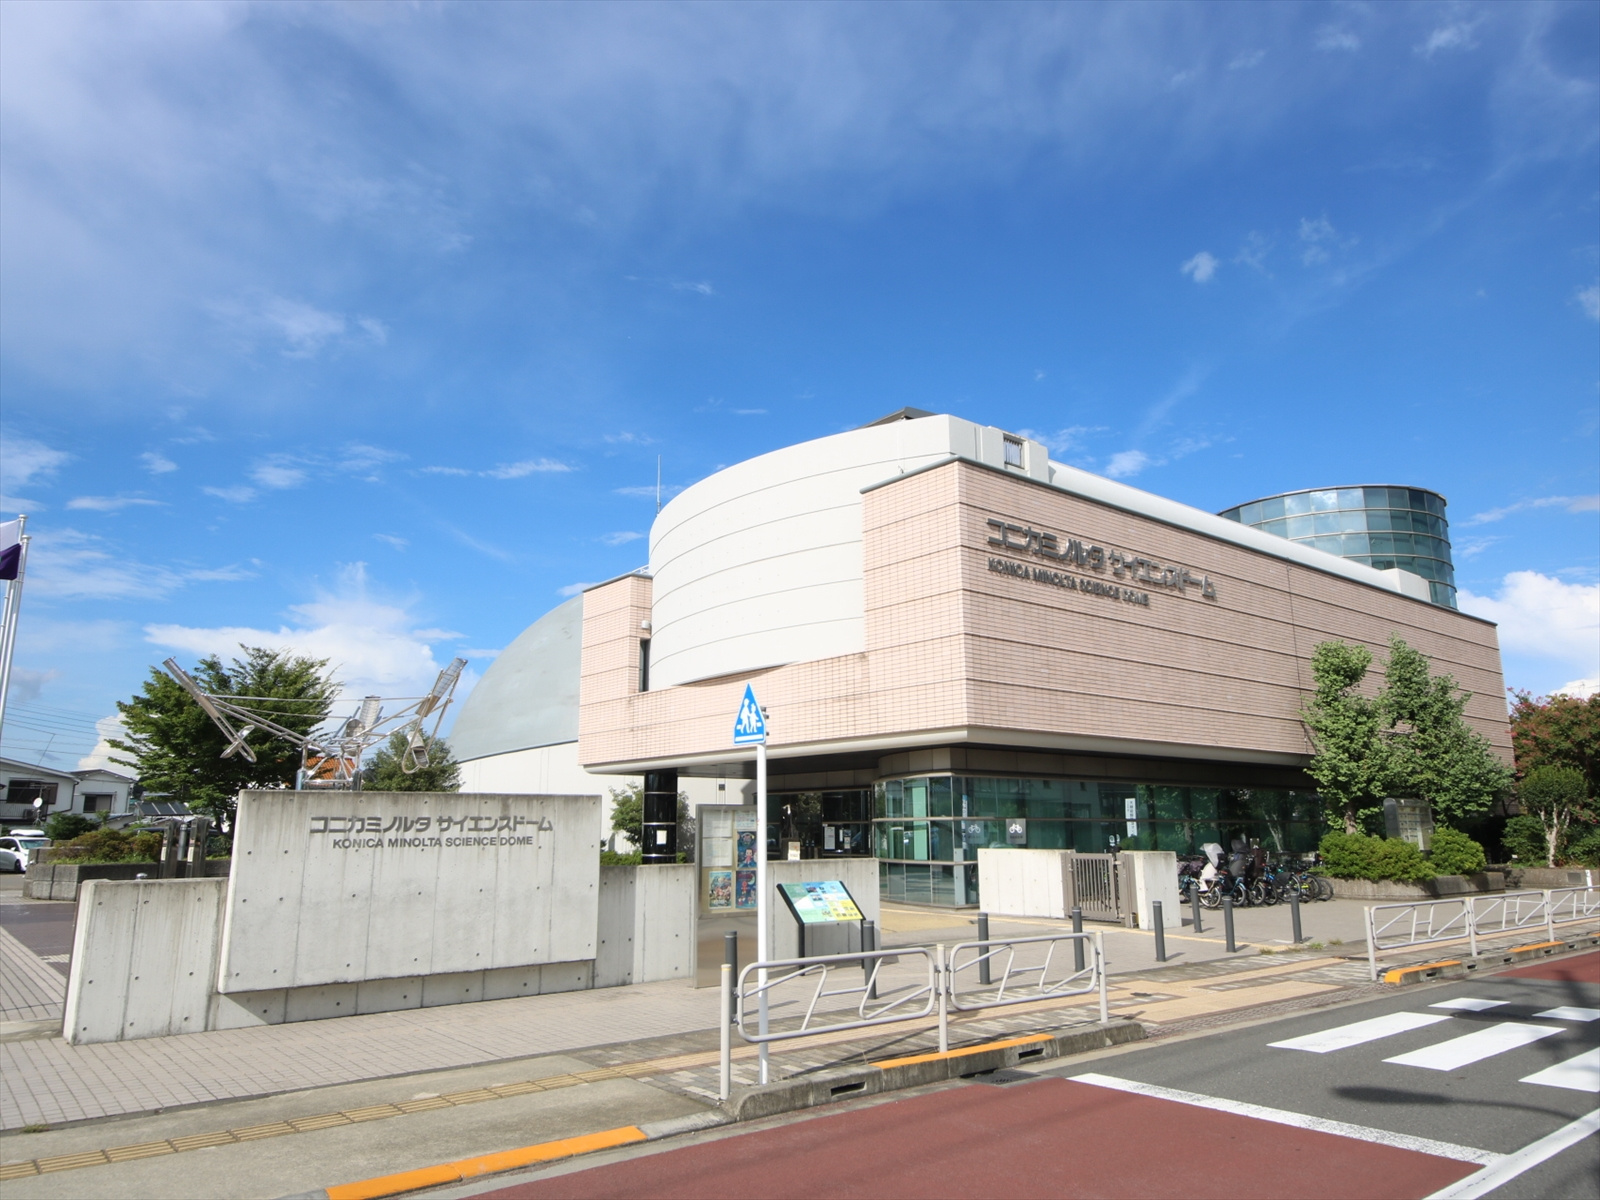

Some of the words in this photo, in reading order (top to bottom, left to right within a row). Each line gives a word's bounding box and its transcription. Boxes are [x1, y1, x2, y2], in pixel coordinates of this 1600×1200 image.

[986, 518, 1104, 569] コニカミノルタ
[1108, 549, 1217, 600] サイエンスドーム
[988, 557, 1031, 580] KONICA
[1033, 568, 1078, 590] MINOLTA
[1079, 578, 1120, 600] SCIENCE
[1122, 589, 1150, 607] DOME
[310, 816, 432, 834] コニカミノルタ
[436, 816, 554, 832] サイエンスドーム
[333, 838, 384, 849] KONICA
[387, 837, 442, 848] MINOLTA
[445, 836, 497, 847] SCIENCE
[500, 836, 533, 846] DOME
